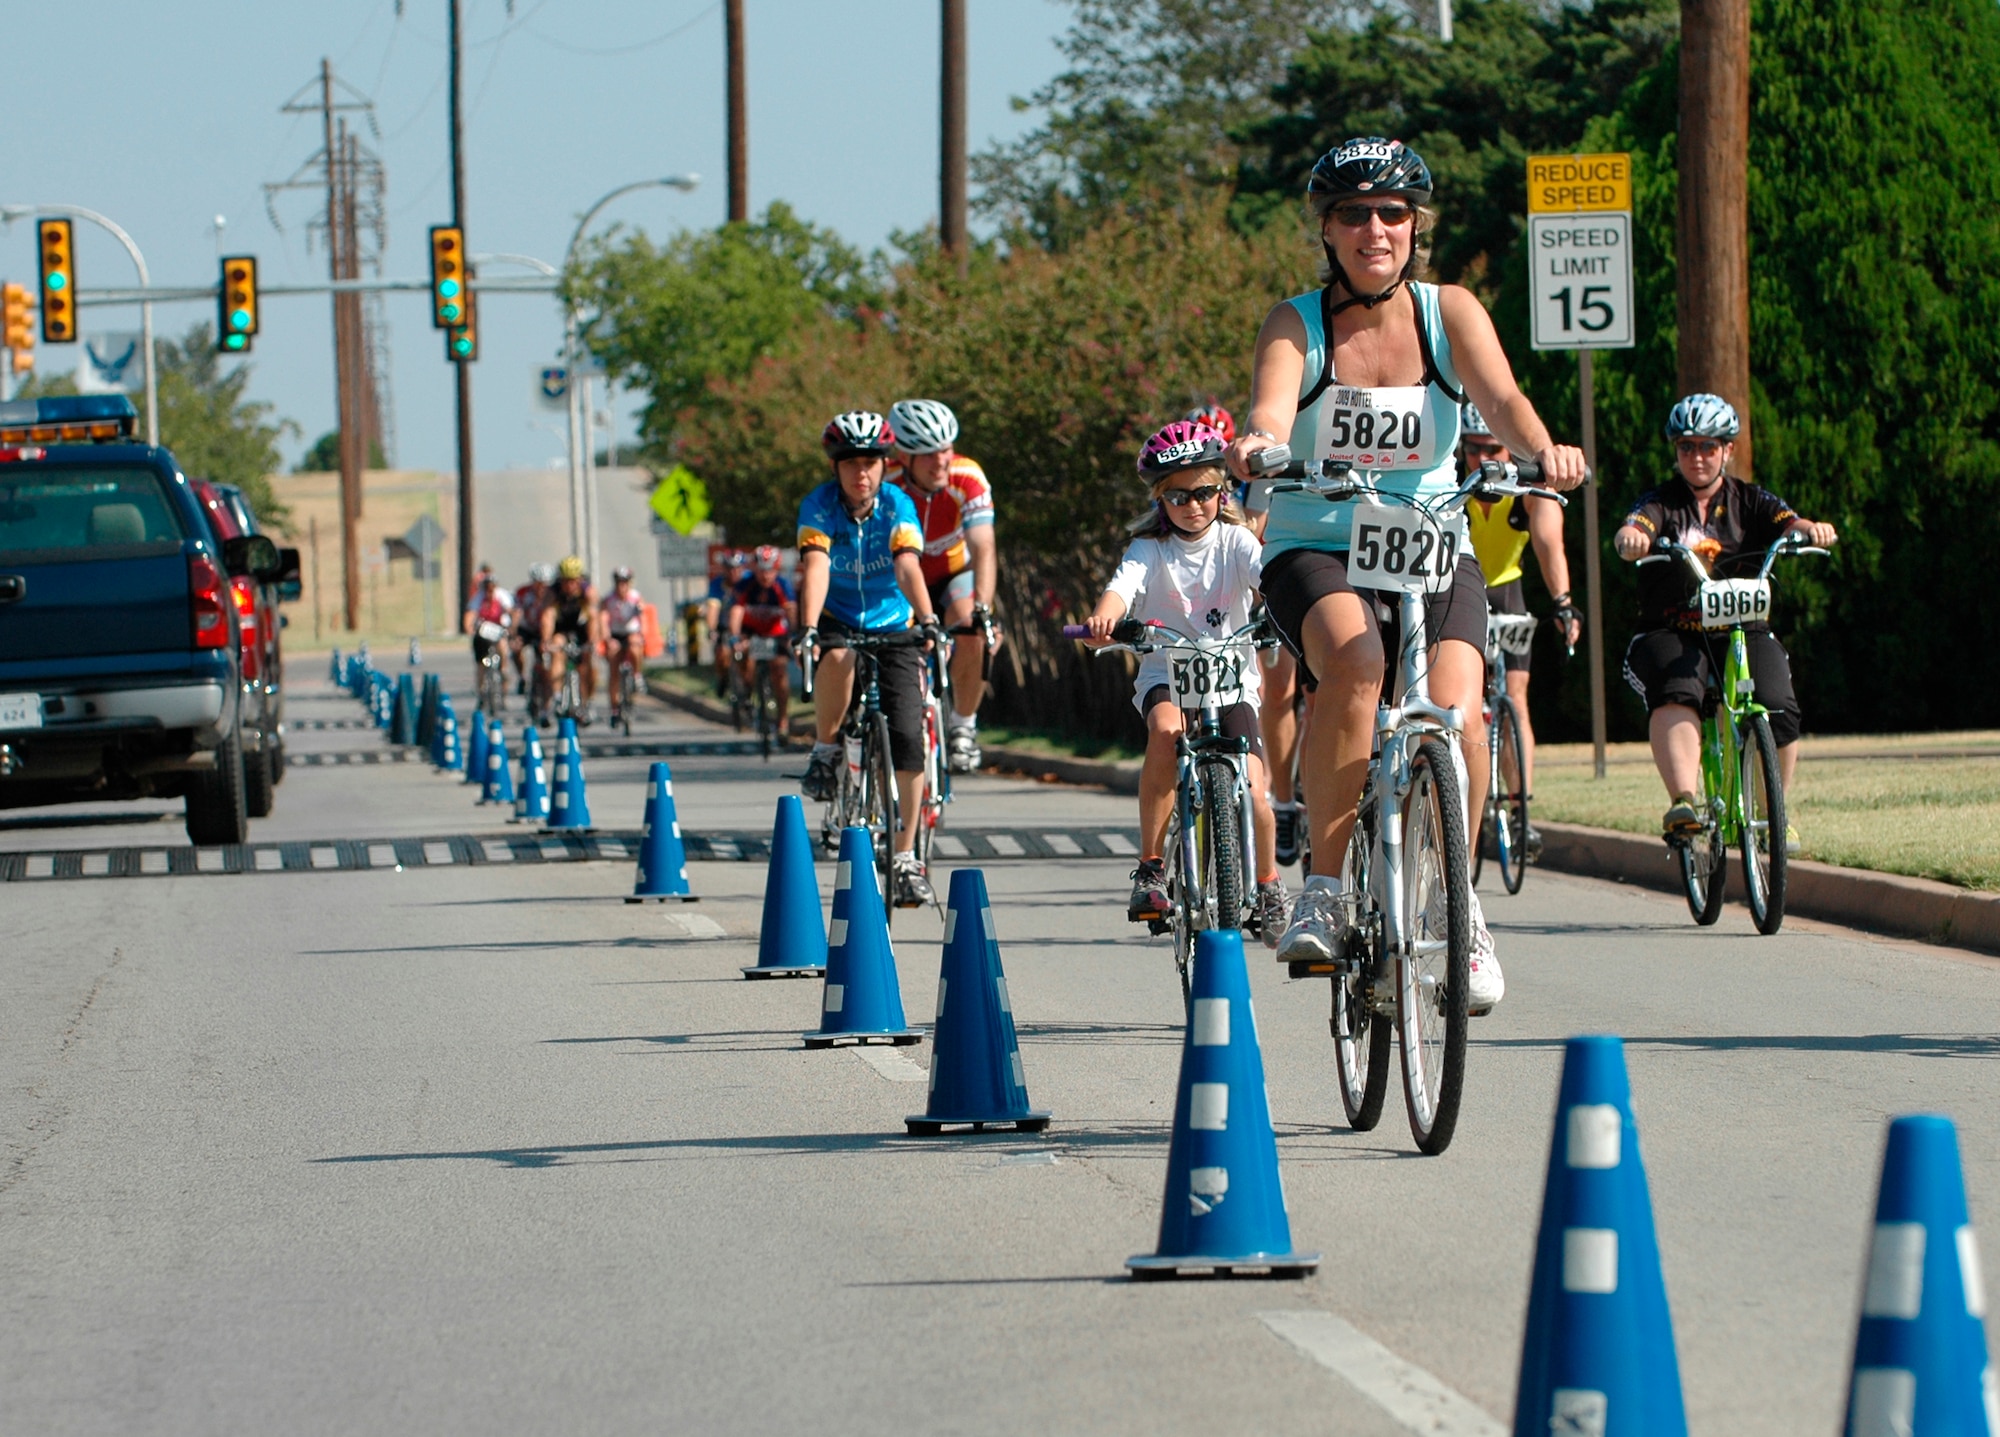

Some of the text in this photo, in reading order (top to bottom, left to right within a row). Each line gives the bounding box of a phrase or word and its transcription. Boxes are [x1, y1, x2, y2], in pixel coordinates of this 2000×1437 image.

[1336, 145, 1387, 162] 5820
[1533, 161, 1624, 182] REDUCE
[1542, 185, 1616, 206] SPEED
[1541, 228, 1620, 248] SPEED
[1550, 256, 1610, 275] LIMIT
[1549, 285, 1614, 331] 15
[1331, 408, 1421, 450] 5820
[1159, 441, 1199, 460] 5821
[1356, 523, 1456, 577] 5820
[832, 553, 893, 574] Columb
[1707, 589, 1766, 619] 9966
[1172, 654, 1243, 695] 5821
